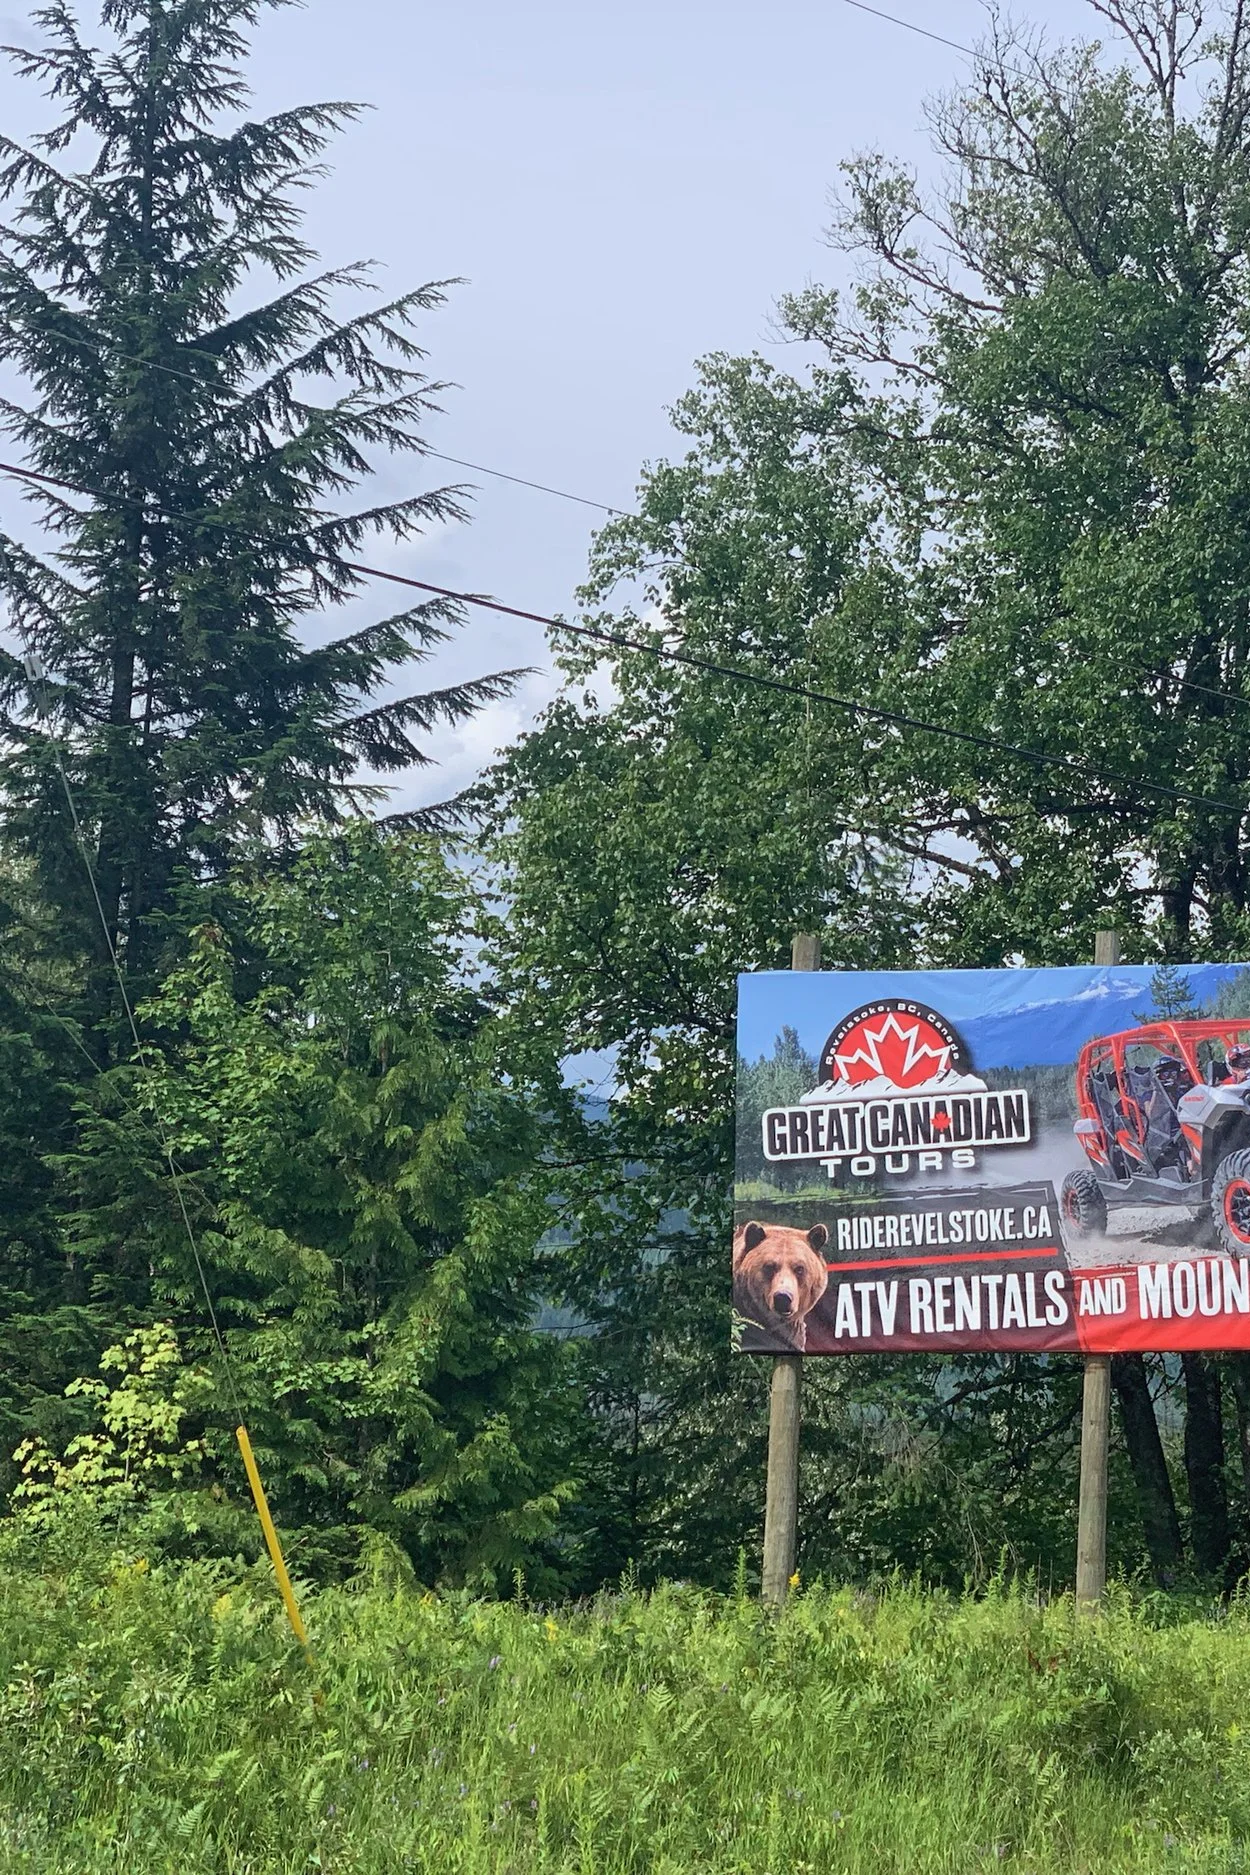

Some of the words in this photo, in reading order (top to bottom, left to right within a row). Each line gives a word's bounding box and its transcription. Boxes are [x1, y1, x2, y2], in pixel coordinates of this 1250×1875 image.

[897, 1002, 921, 1016] BC,
[927, 1013, 960, 1060] Canada
[766, 1106, 861, 1156] GREAT
[869, 1093, 1026, 1149] CANADIAN
[820, 1148, 976, 1178] TOURS
[837, 1205, 1053, 1251] RIDEREVELSTOKE.CA
[834, 1280, 899, 1339] ATV
[909, 1271, 1069, 1334] RENTALS
[1079, 1278, 1127, 1316] AND
